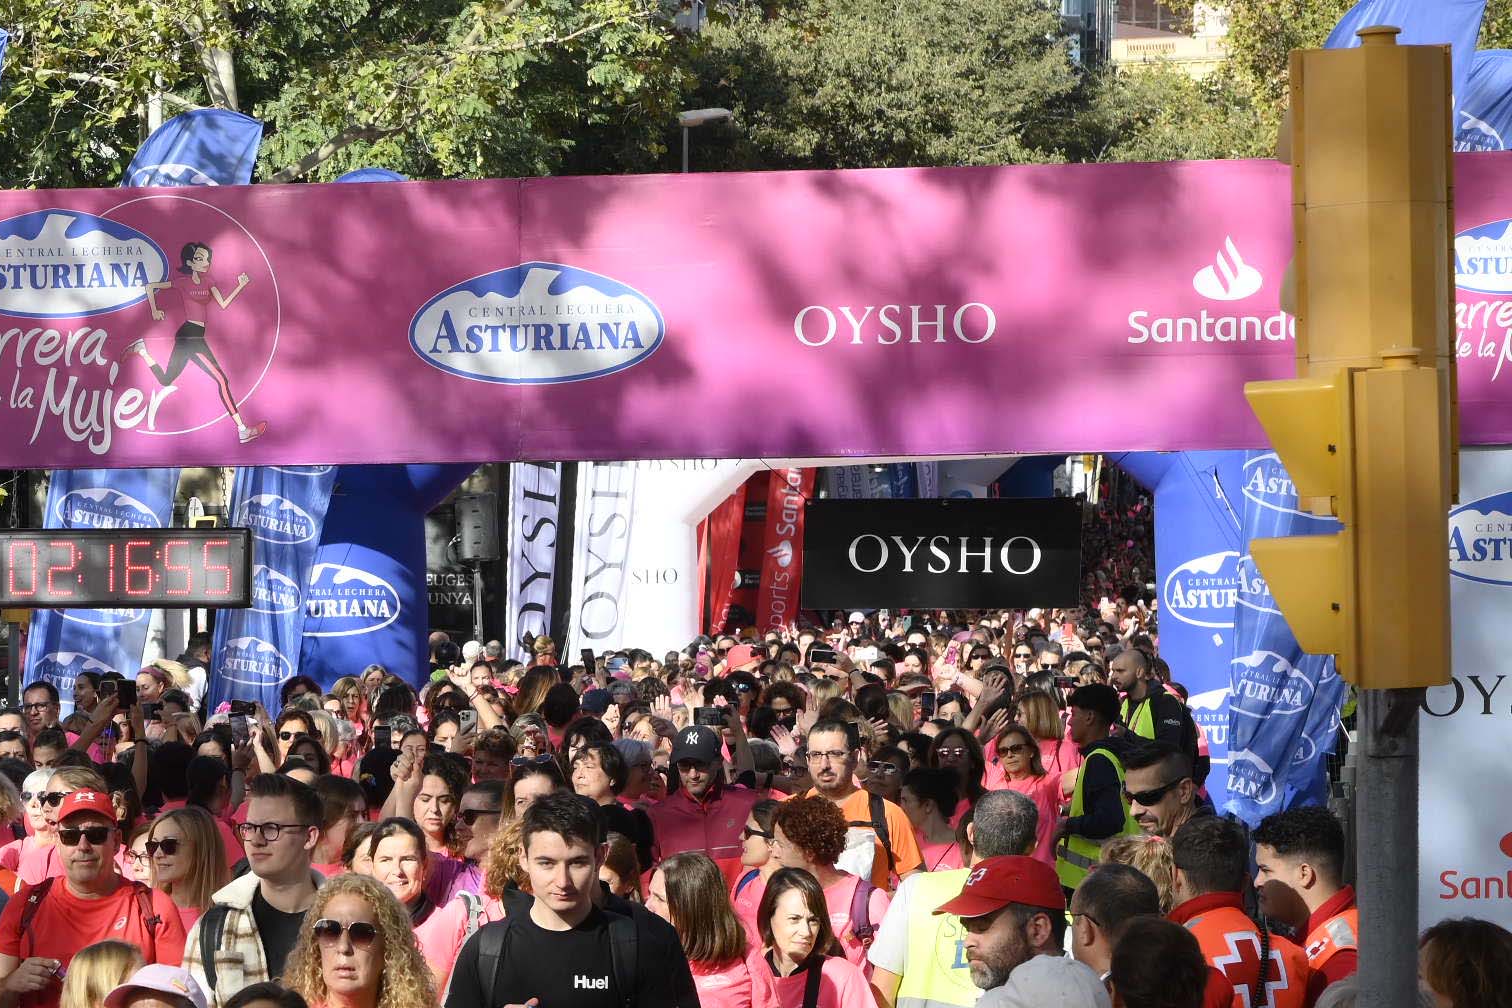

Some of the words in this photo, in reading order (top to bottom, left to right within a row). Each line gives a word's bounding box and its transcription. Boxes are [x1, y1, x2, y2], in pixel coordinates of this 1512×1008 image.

[71, 246, 144, 257] LECHERA
[468, 305, 546, 317] CENTRAL
[554, 303, 637, 315] LECHERA
[793, 302, 996, 347] OYSHO
[429, 308, 644, 354] ASTURIANA
[1477, 328, 1496, 358] la
[9, 371, 35, 409] la
[30, 356, 177, 455] Mujer
[8, 539, 231, 596] 02:16:55
[848, 533, 1042, 575] OYSHO
[631, 567, 679, 585] SHO
[309, 588, 333, 597] TRAL
[337, 588, 386, 597] LECHERA
[574, 974, 609, 990] Huel
